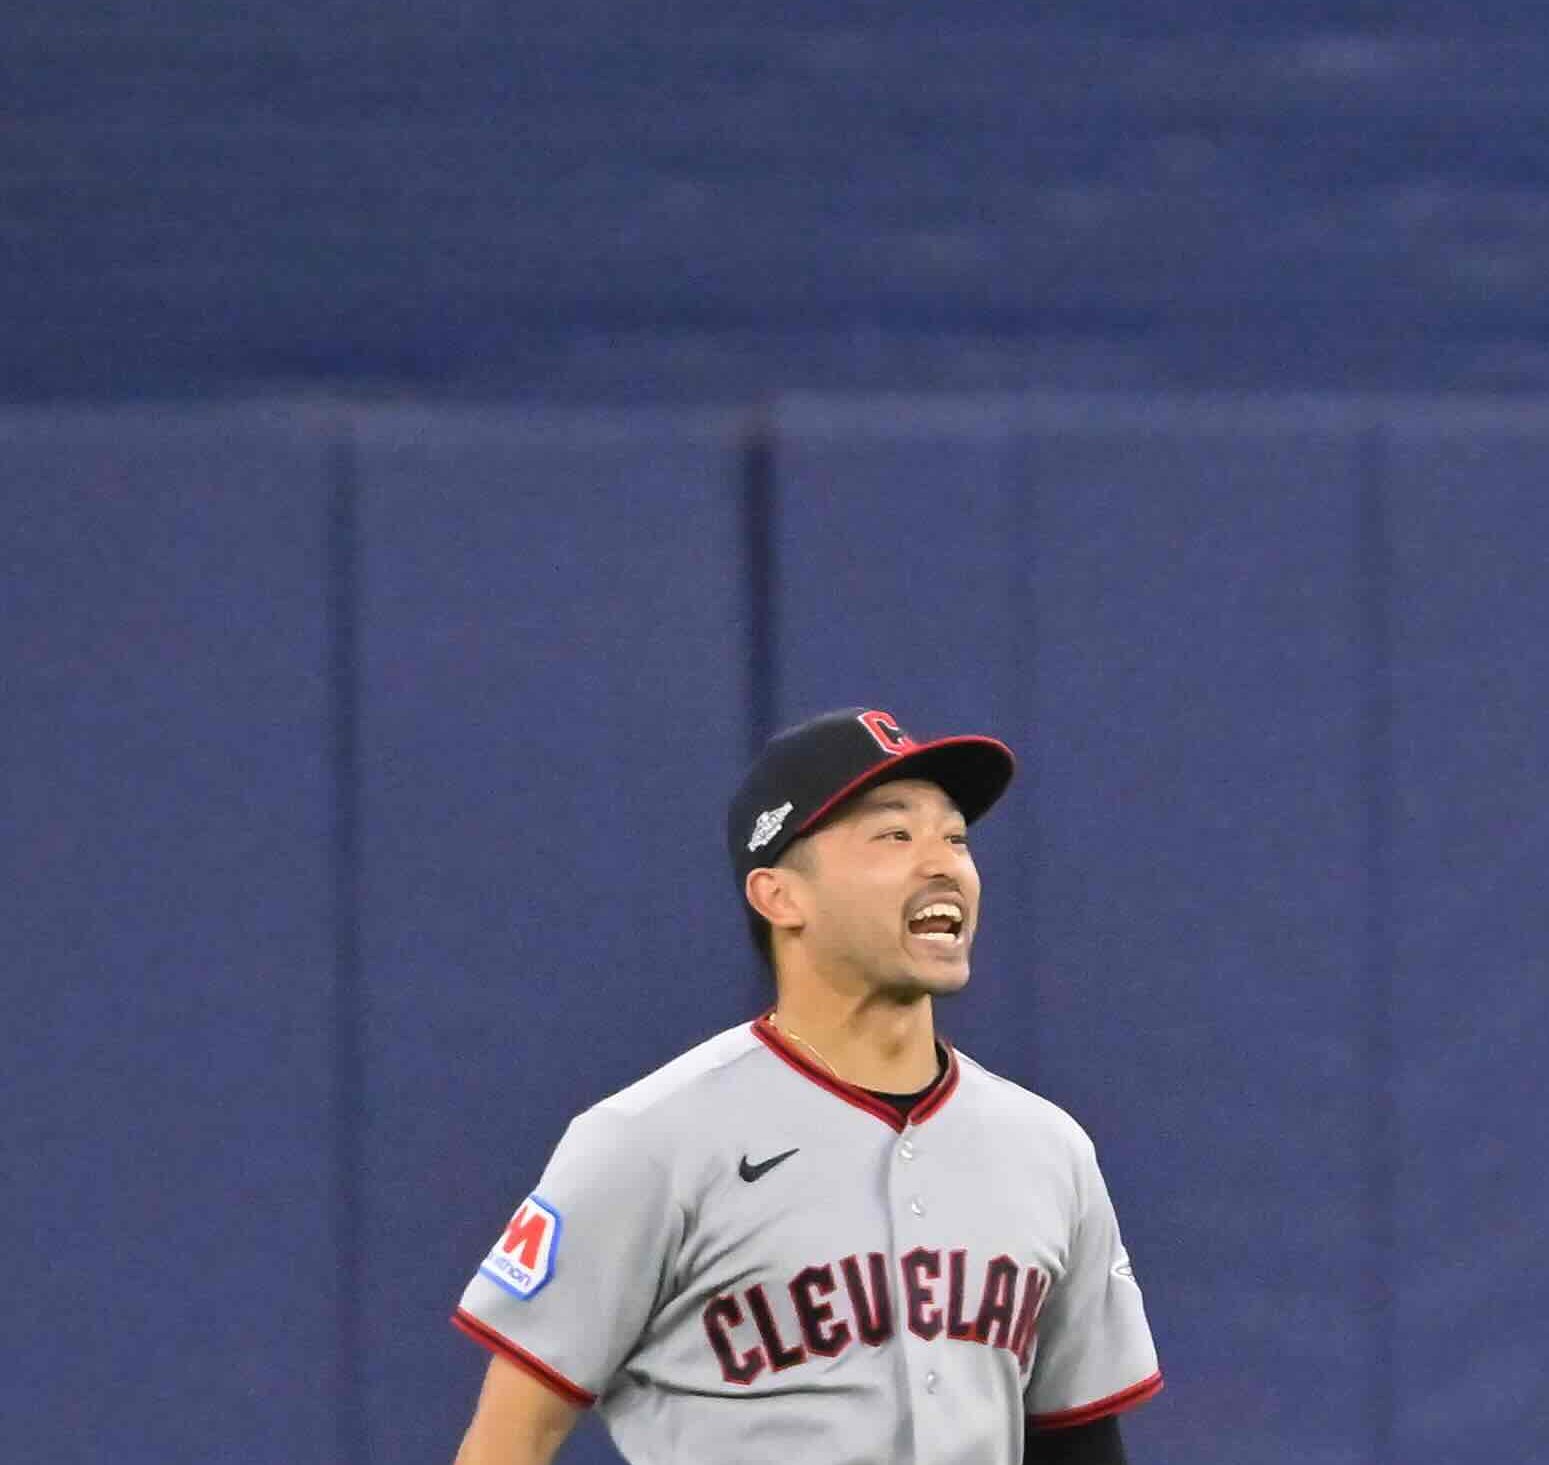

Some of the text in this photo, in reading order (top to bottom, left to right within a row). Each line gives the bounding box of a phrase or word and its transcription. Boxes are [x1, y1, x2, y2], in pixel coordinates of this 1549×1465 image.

[857, 710, 905, 755] C
[502, 1202, 547, 1271] M
[702, 1246, 1050, 1387] CLEVELAN
